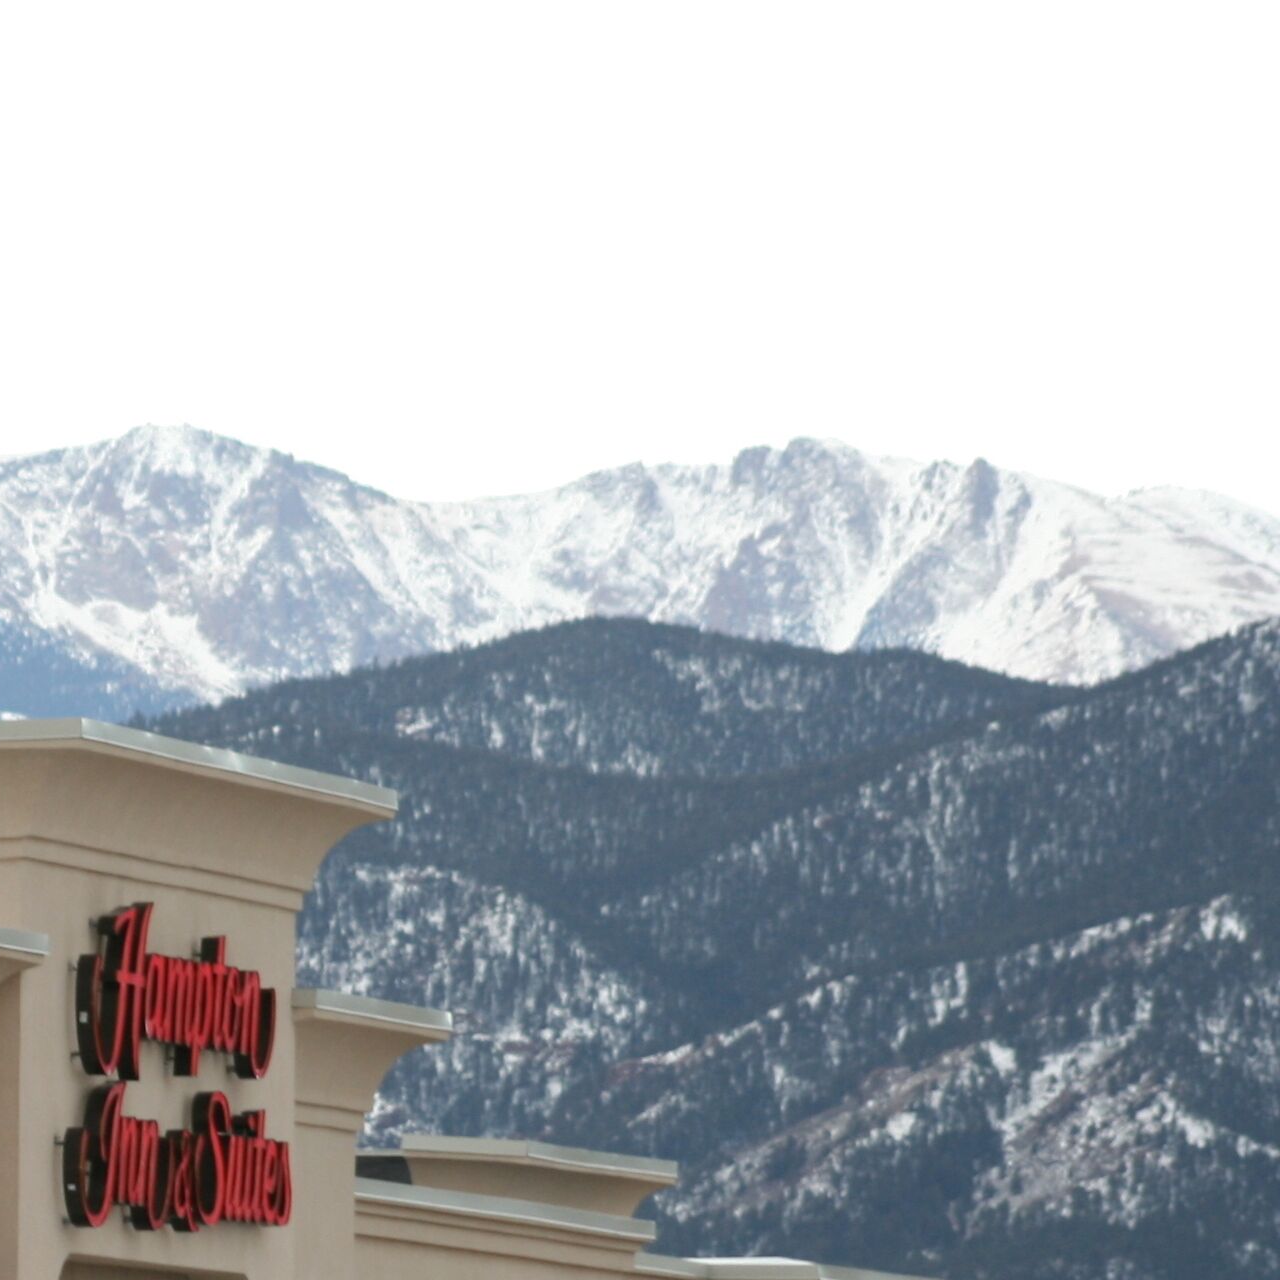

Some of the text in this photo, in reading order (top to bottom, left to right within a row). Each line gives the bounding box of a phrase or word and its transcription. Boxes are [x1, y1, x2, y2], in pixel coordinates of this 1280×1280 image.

[76, 901, 276, 1080] Hampton
[64, 1081, 174, 1230] Inn
[192, 1090, 292, 1226] Suites
